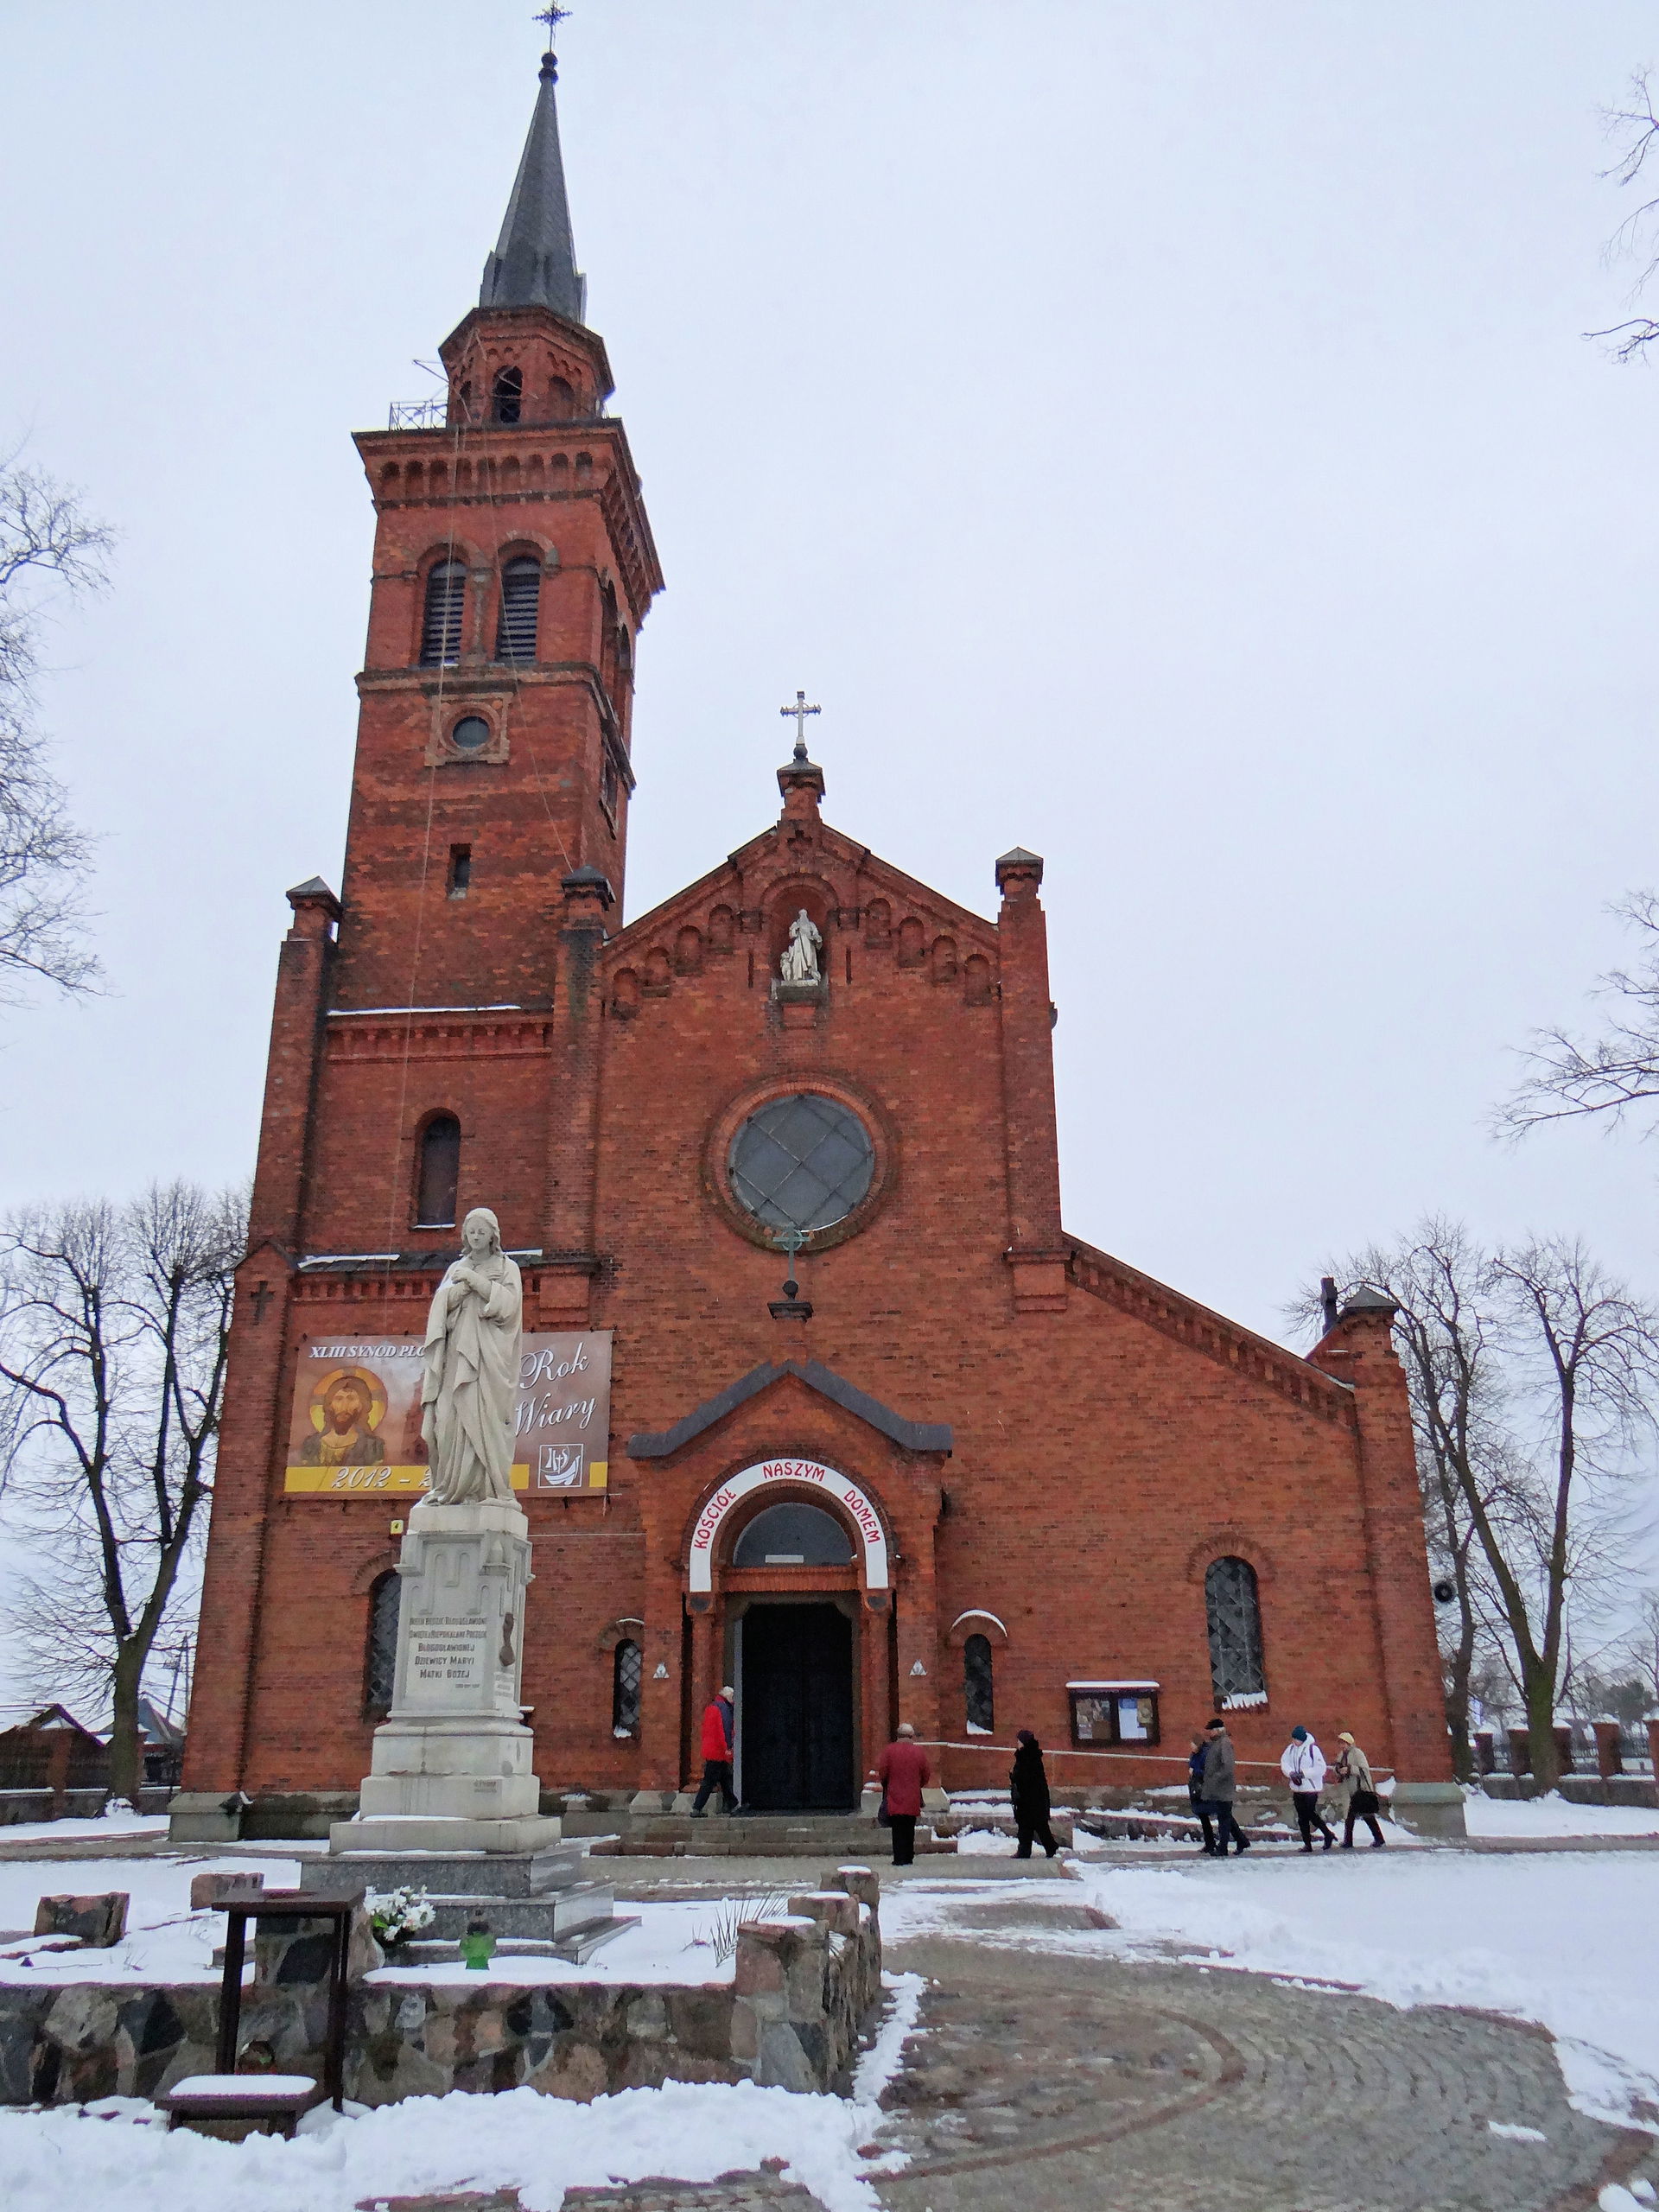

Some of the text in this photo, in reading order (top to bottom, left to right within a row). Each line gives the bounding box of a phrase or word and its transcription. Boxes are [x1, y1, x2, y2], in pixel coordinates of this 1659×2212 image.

[308, 1345, 347, 1359] XLIII
[347, 1345, 397, 1358] SYNOD
[520, 1341, 590, 1390] Rok
[516, 1392, 597, 1438] Wiary
[332, 1465, 392, 1489] 2012
[694, 1461, 880, 1549] KOŚCIÓŁ NASZYM DOMEM
